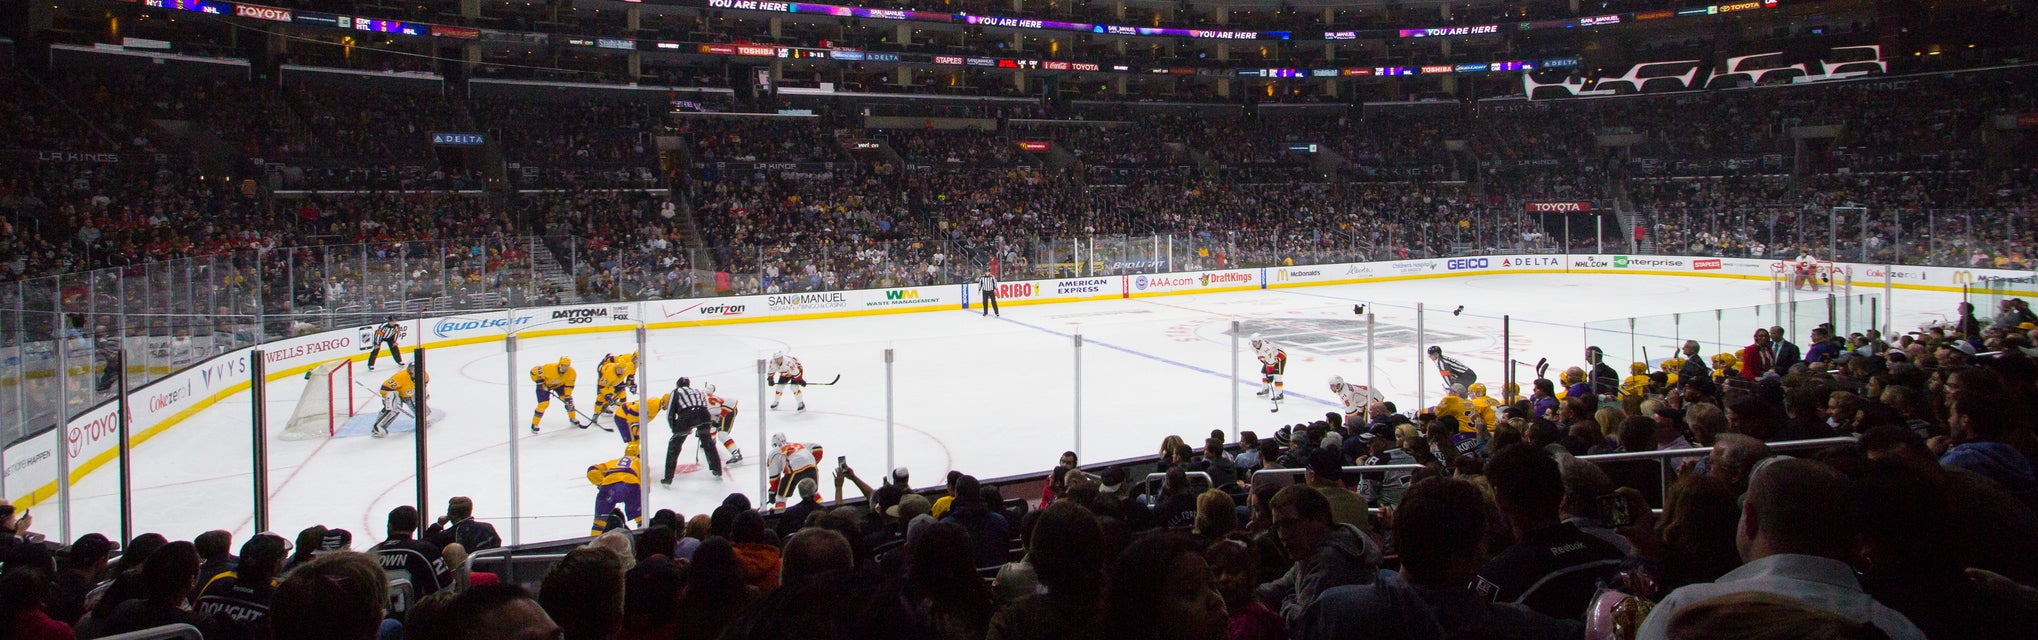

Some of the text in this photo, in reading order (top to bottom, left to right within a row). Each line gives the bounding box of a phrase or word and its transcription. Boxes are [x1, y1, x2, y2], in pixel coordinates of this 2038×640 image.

[204, 6, 220, 15] NHL
[709, 0, 788, 11] YOU ARE HERE
[1731, 2, 1760, 10] TOYOTA
[236, 5, 292, 21] TOYOTA
[979, 17, 1042, 28] YOU ARE HERE
[1199, 30, 1257, 40] YOU ARE HERE
[1428, 26, 1497, 36] YOU ARE HERE
[738, 46, 775, 55] TOSHIBA
[874, 54, 898, 62] DELTA
[936, 56, 962, 64] STAPLES
[1071, 63, 1099, 71] TOYOTA
[446, 135, 483, 143] DELTA
[68, 152, 119, 163] KINGS
[1535, 203, 1579, 211] TOYOTA
[1447, 257, 1487, 270] GEICO
[1514, 257, 1558, 267] DELTA
[1574, 260, 1608, 268] NHL.COM
[1211, 271, 1252, 283] DraftKings
[1290, 269, 1320, 277] McDonald's
[1058, 278, 1107, 288] AMERICAN
[1149, 277, 1193, 288] AAA.com
[886, 289, 918, 301] WM
[994, 283, 1031, 299] ARIBO
[1058, 286, 1099, 295] EXPRESS
[768, 293, 846, 306] SAN MANUEL
[892, 298, 939, 306] MANAGEMENT
[552, 308, 608, 319] DAYTONA
[699, 303, 745, 316] verizon
[568, 316, 593, 324] 500
[613, 313, 629, 321] FOX
[266, 337, 350, 364] WELLS FARGO
[149, 392, 169, 413] Coke
[617, 456, 632, 468] 8
[1550, 541, 1586, 557] Reebok
[378, 553, 408, 567] OWN
[199, 602, 266, 622] DOUGHT
